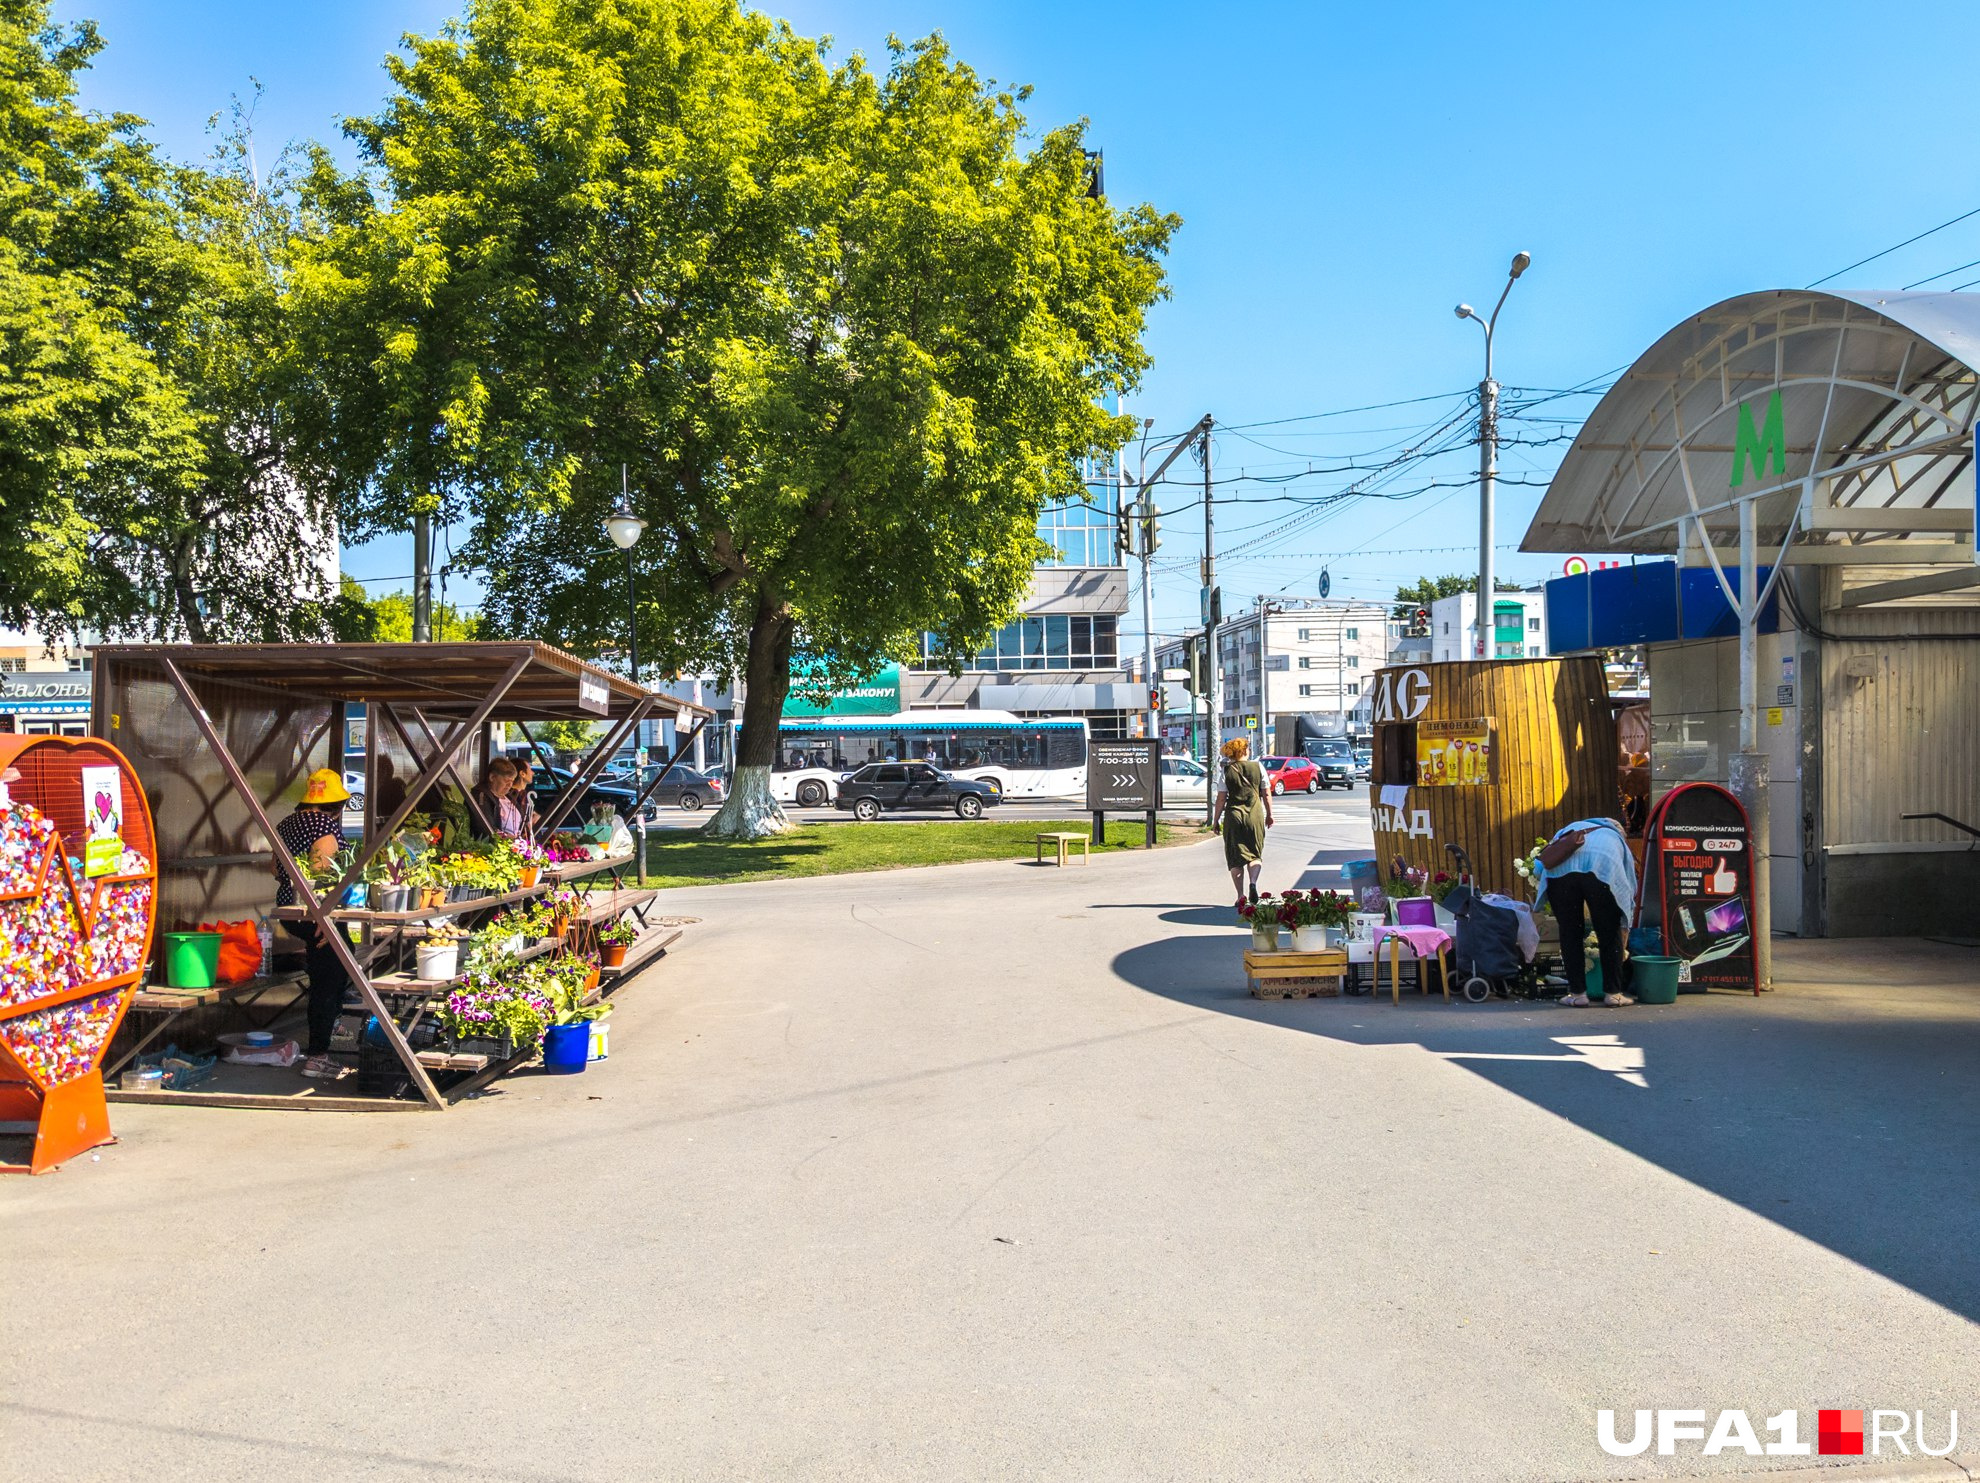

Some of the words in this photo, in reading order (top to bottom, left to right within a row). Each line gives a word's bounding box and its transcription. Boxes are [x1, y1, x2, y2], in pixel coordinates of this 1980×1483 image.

[845, 688, 895, 697] ЗАКОНУ!
[1718, 841, 1737, 849] 24/7
[1673, 855, 1713, 869] ВЫГОДНО
[1300, 976, 1336, 985] GAUCHO
[1262, 988, 1299, 996] GAUCHO
